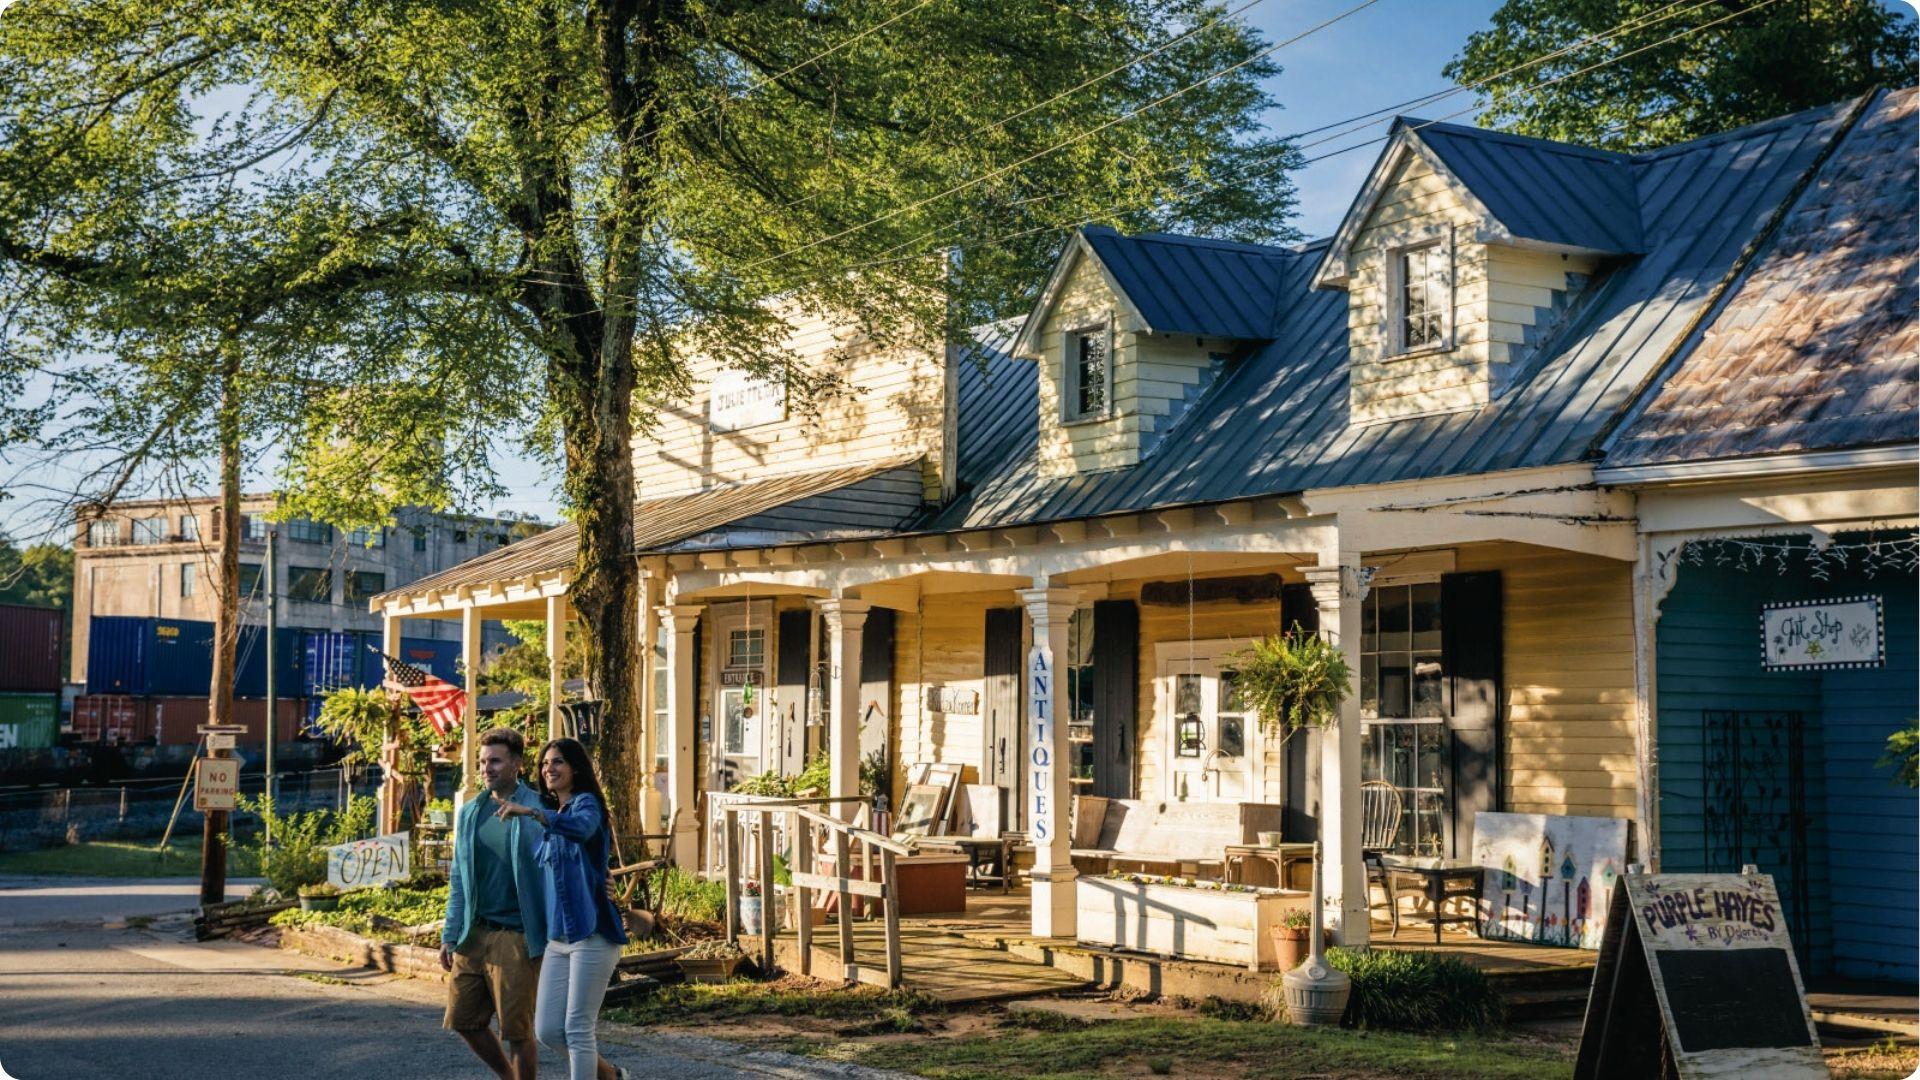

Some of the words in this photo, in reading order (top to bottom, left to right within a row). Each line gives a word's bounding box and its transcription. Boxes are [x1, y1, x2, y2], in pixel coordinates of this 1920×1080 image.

[1032, 652, 1049, 840] ANTIQUES
[209, 772, 227, 782] NO
[200, 787, 234, 796] PARKING
[341, 840, 404, 884] OPEN
[1643, 888, 1712, 936] PURPLE
[1714, 891, 1775, 932] HAYES
[1708, 926, 1721, 939] BY
